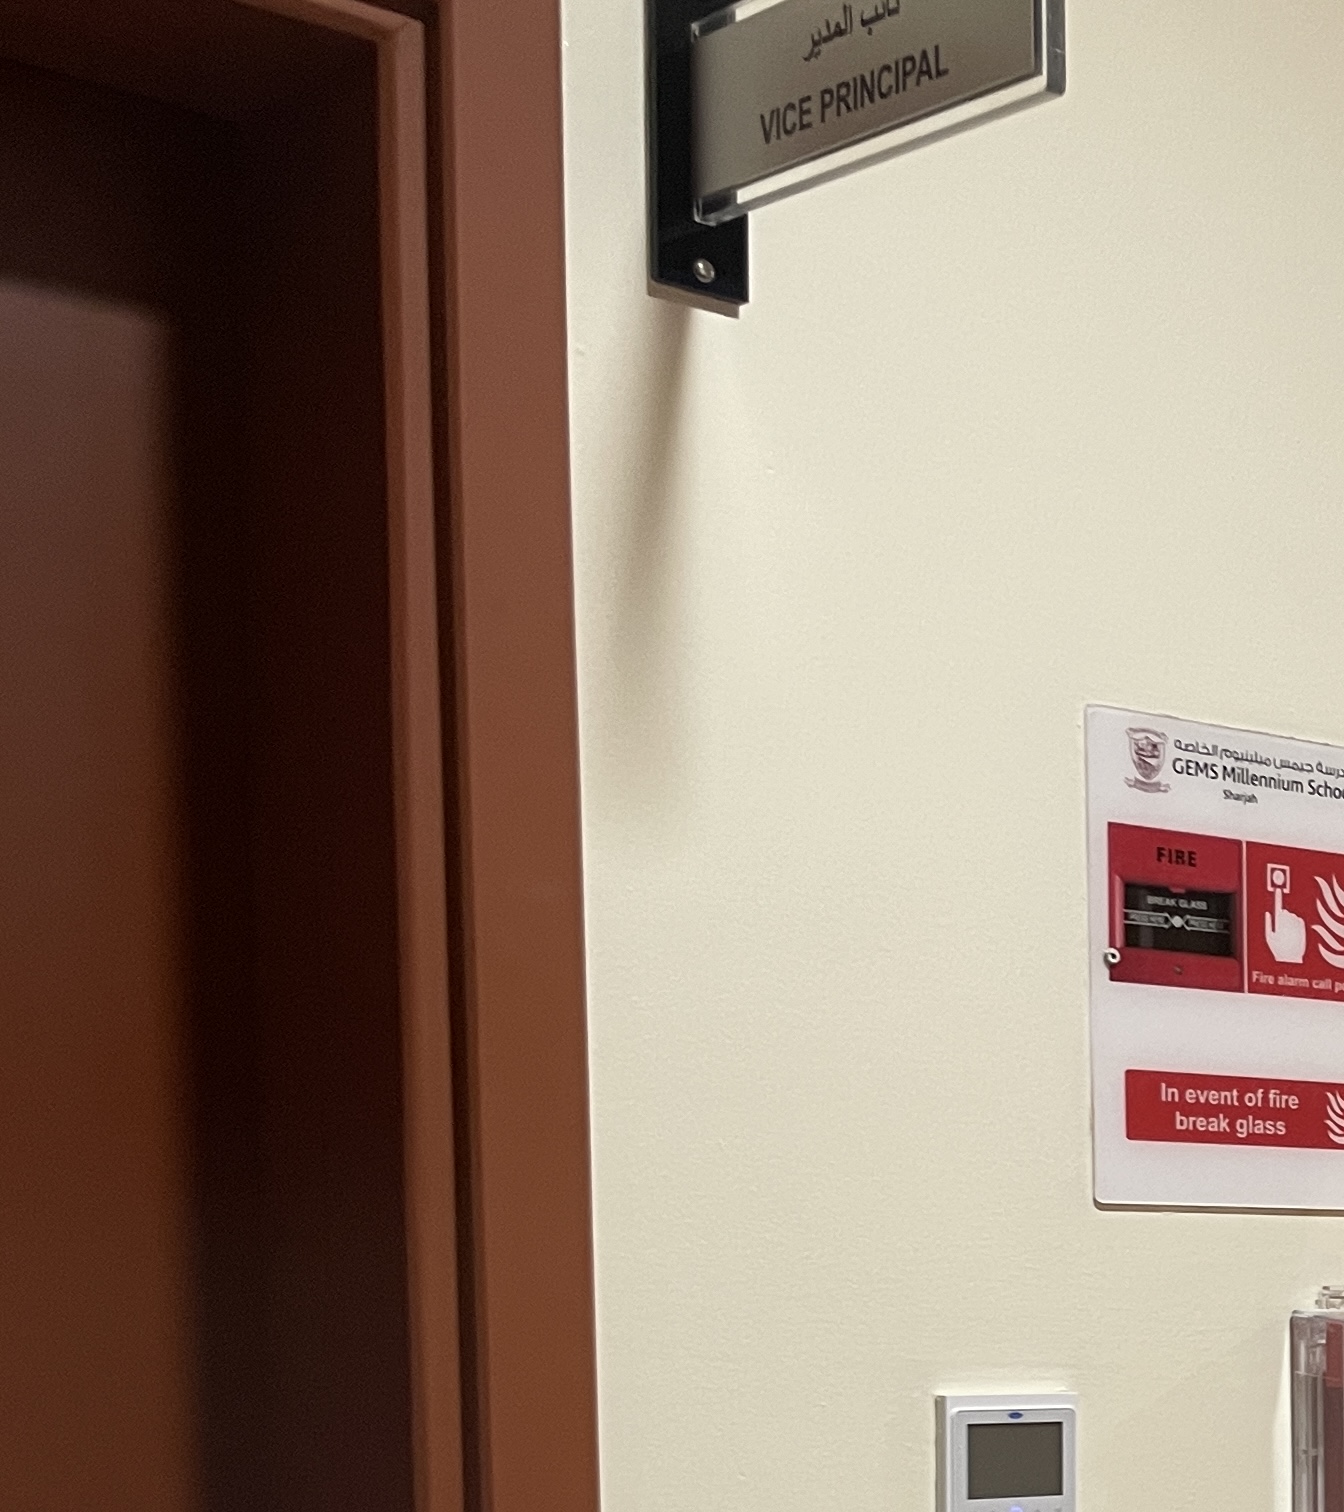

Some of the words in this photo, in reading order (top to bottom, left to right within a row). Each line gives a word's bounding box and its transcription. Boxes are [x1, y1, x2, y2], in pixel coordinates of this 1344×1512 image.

[759, 94, 813, 145] VICE
[819, 43, 949, 124] PRINCIPAL
[1171, 756, 1219, 780] GEMS
[1221, 764, 1304, 794] Millennium
[1155, 846, 1197, 868] FIRE
[1251, 970, 1275, 985] Fire
[1276, 973, 1310, 988] alarm
[1311, 978, 1332, 990] call
[1160, 1081, 1179, 1102] In
[1184, 1087, 1239, 1106] event
[1243, 1089, 1264, 1107] of
[1267, 1090, 1299, 1109] fire
[1175, 1110, 1230, 1133] break
[1235, 1115, 1286, 1138] glass
